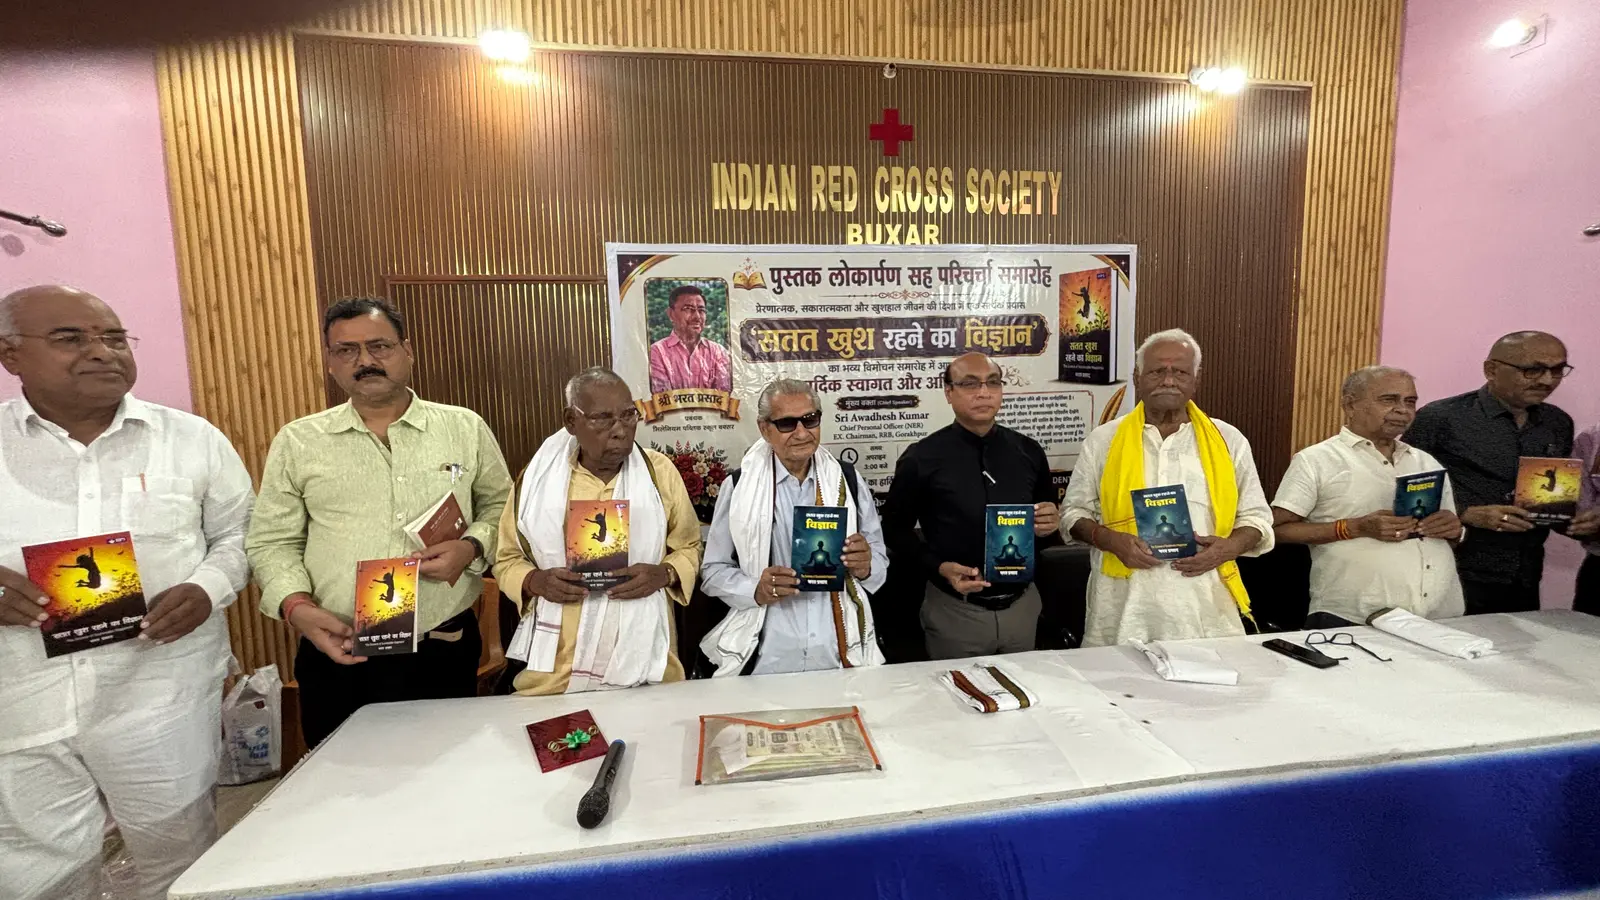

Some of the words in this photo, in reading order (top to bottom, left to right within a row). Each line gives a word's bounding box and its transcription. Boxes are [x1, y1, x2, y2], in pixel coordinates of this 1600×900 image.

[712, 162, 797, 212] INDIAN
[811, 165, 858, 212] RED
[875, 166, 954, 214] CROSS
[966, 167, 1062, 215] SOCIETY
[847, 223, 940, 246] BUXAR
[769, 267, 822, 295] पुस्तक
[828, 259, 902, 287] लोकार्पण
[907, 266, 933, 288] सह
[937, 258, 993, 287] परिचर्चा
[998, 258, 1052, 288] समारोह
[800, 303, 851, 313] सकारात्मकता
[854, 302, 869, 312] और
[871, 303, 901, 315] खुशहाल
[903, 301, 924, 312] जीवन
[926, 301, 937, 311] की
[826, 327, 875, 359] खुश
[882, 322, 924, 351] रहने
[930, 327, 957, 349] का
[828, 364, 840, 373] का
[842, 363, 861, 373] भव्य
[863, 361, 894, 372] विमोचन
[897, 360, 926, 371] समारोह
[928, 359, 936, 370] में
[846, 378, 893, 392] स्वागत
[897, 372, 922, 390] और
[659, 395, 671, 406] श्री
[674, 393, 695, 404] भरत
[697, 393, 723, 405] प्रसाद
[835, 413, 848, 422] Sri
[851, 412, 896, 422] Awadhesh
[899, 411, 929, 420] Kumar
[857, 423, 882, 431] Personal
[845, 432, 878, 440] Chairman,
[895, 430, 928, 438] Gorakhpur
